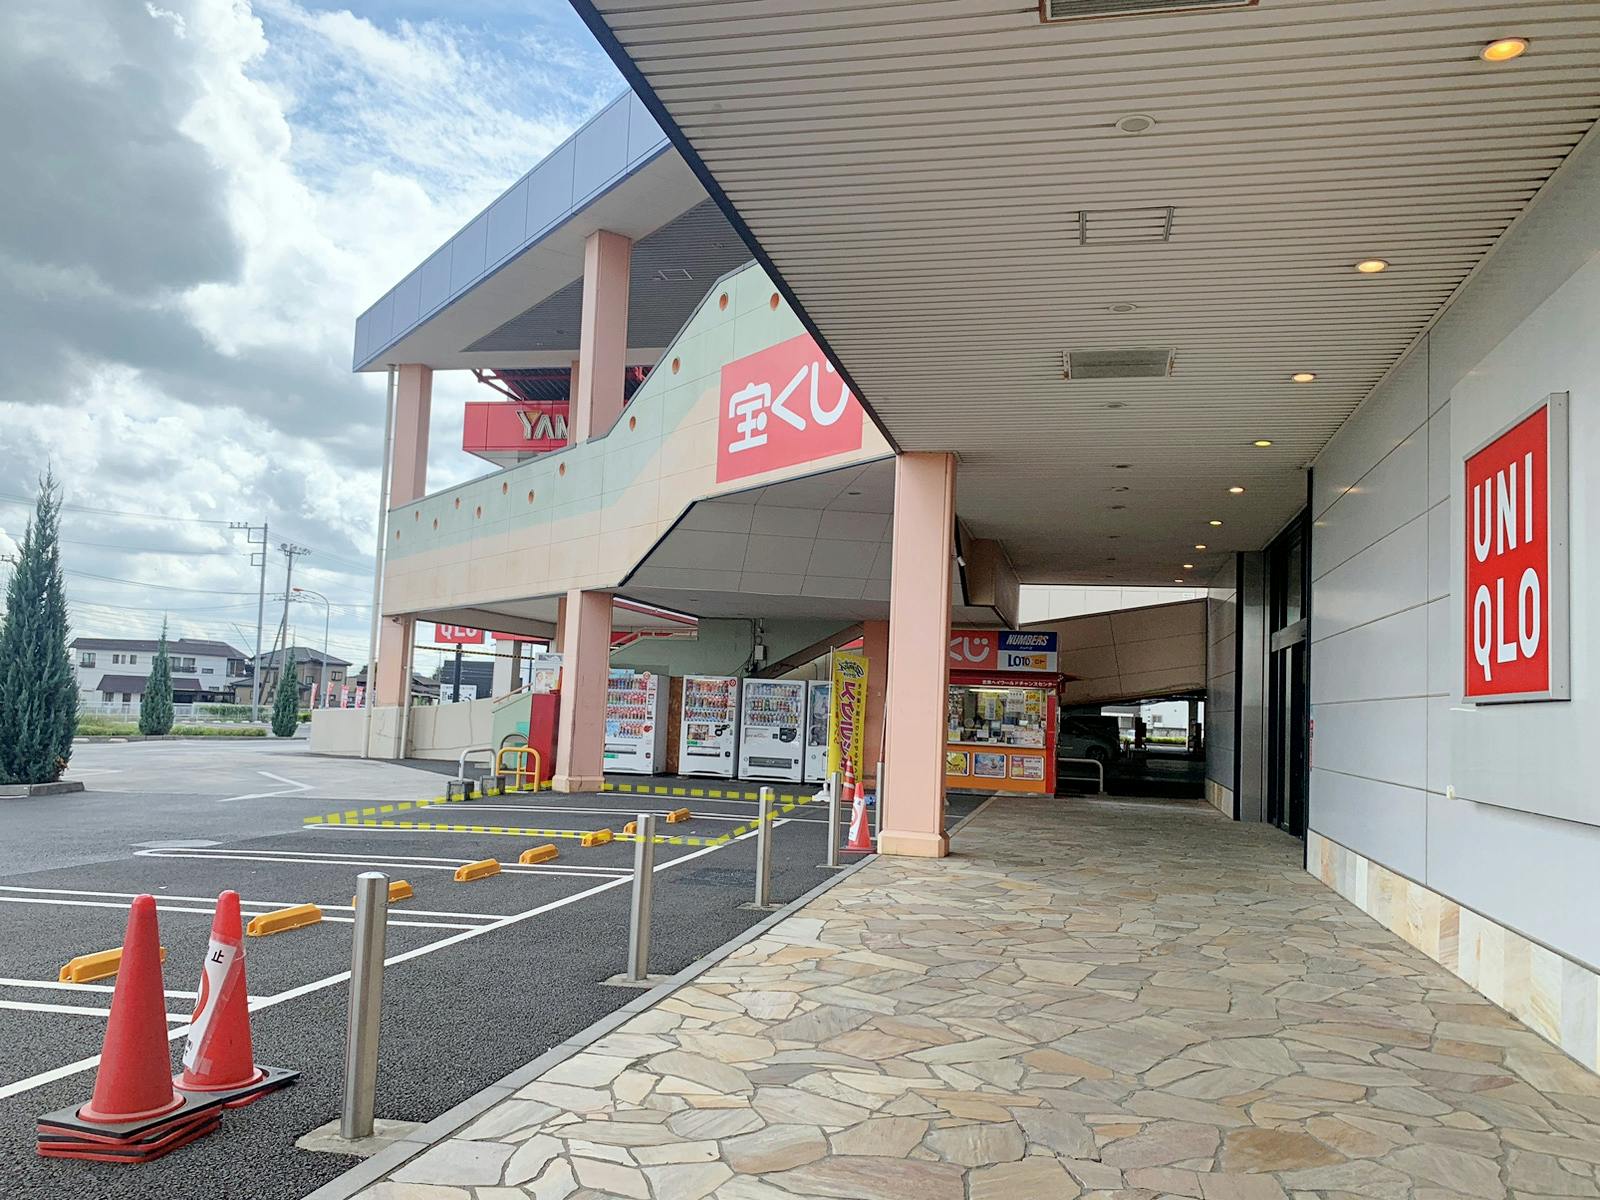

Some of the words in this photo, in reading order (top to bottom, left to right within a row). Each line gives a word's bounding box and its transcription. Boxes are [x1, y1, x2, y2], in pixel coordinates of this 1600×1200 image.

[728, 361, 850, 453] 宝くじ
[1474, 451, 1533, 563] UNI
[1006, 634, 1049, 646] NUMBERS
[1474, 567, 1541, 682] QLO
[1008, 654, 1031, 668] LOTO
[211, 950, 225, 964] 止
